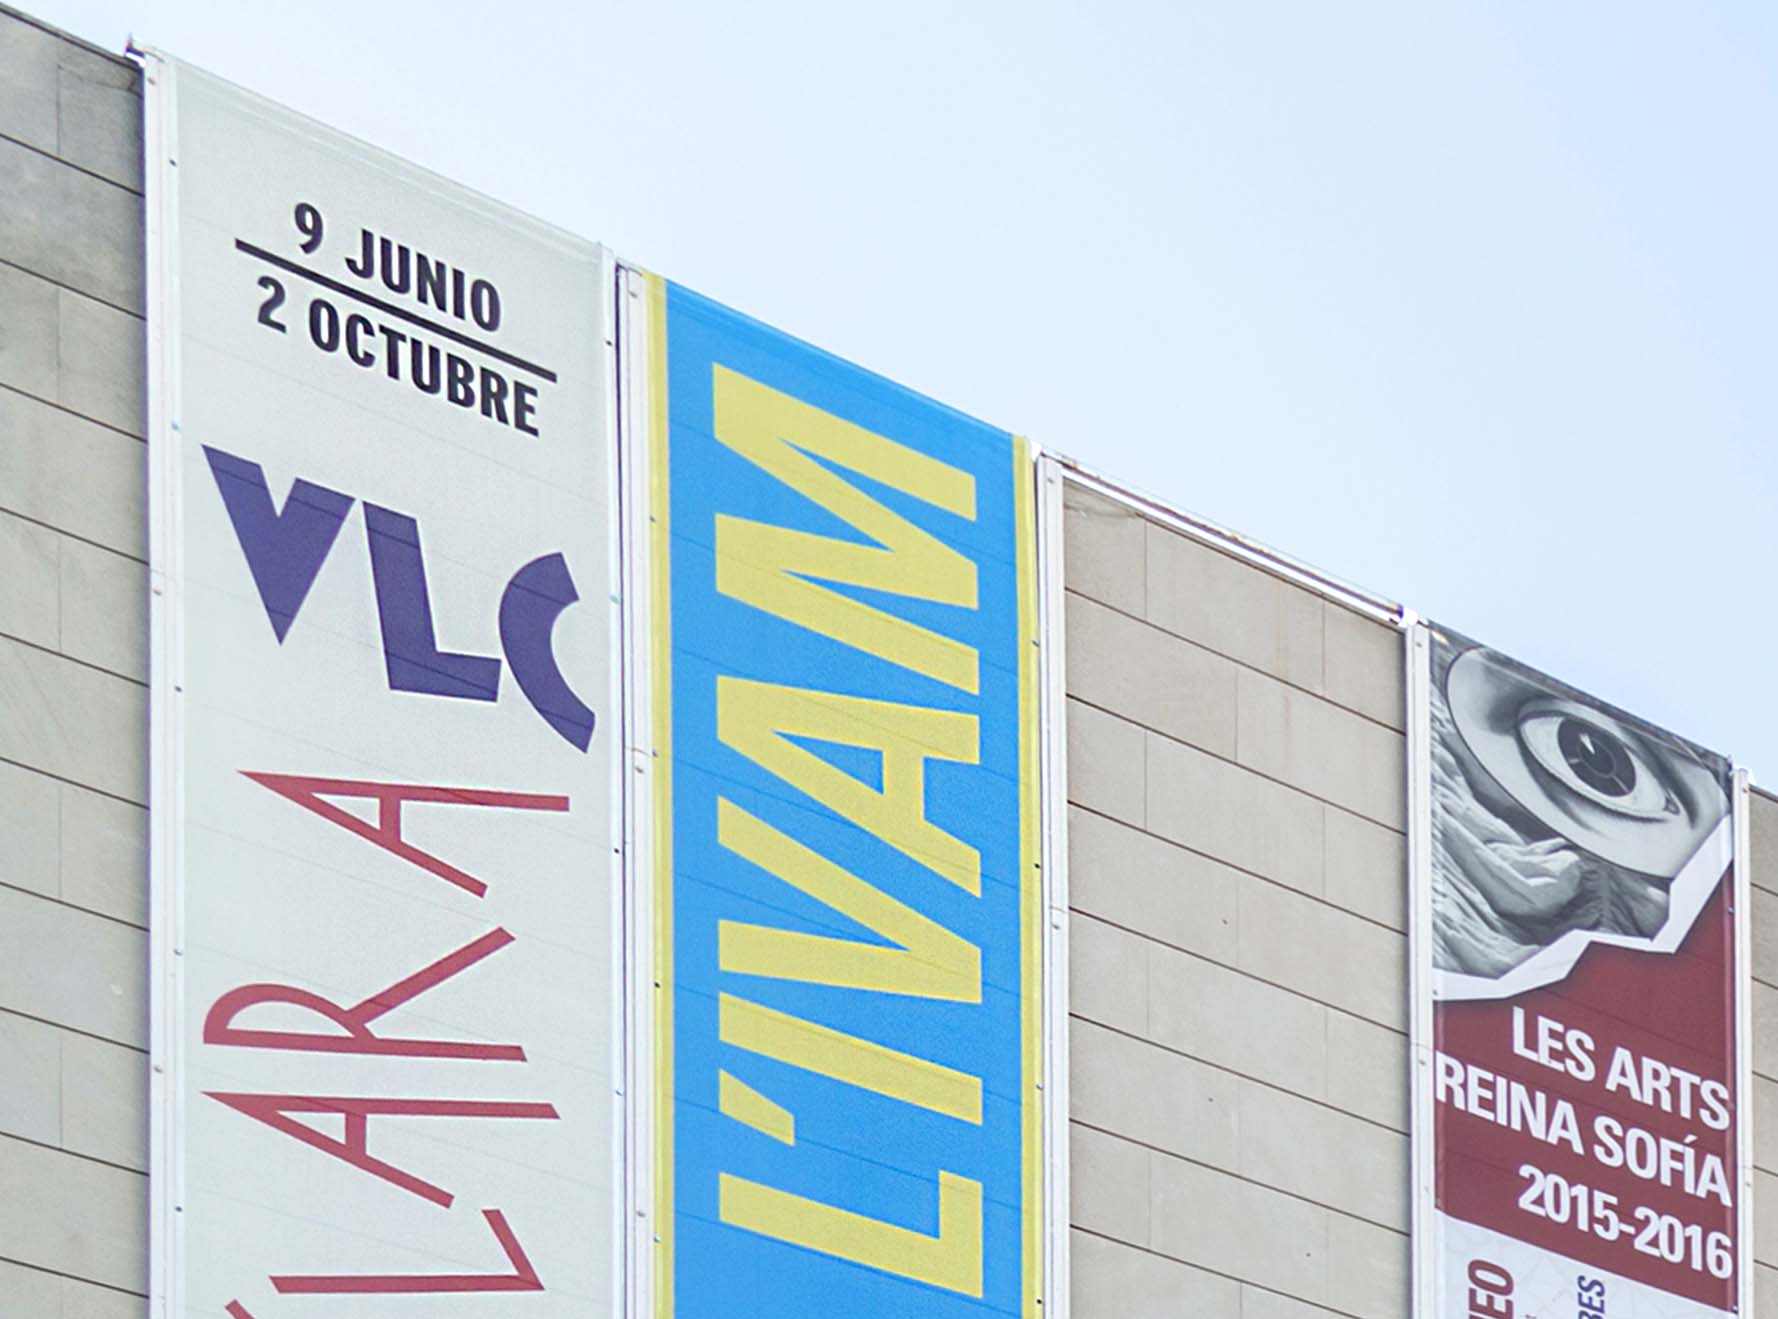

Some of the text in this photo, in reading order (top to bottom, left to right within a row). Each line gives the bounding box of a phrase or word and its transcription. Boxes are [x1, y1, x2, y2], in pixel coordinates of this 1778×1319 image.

[294, 202, 502, 332] 9 JUNIO
[257, 275, 540, 437] 2 OCTUBRE
[201, 443, 596, 755] VLC
[712, 362, 984, 1298] L'IVAM
[1436, 1050, 1732, 1208] REINA SOFÍA
[1513, 1005, 1730, 1131] LES ARTS
[1518, 1163, 1733, 1280] 2015-2016
